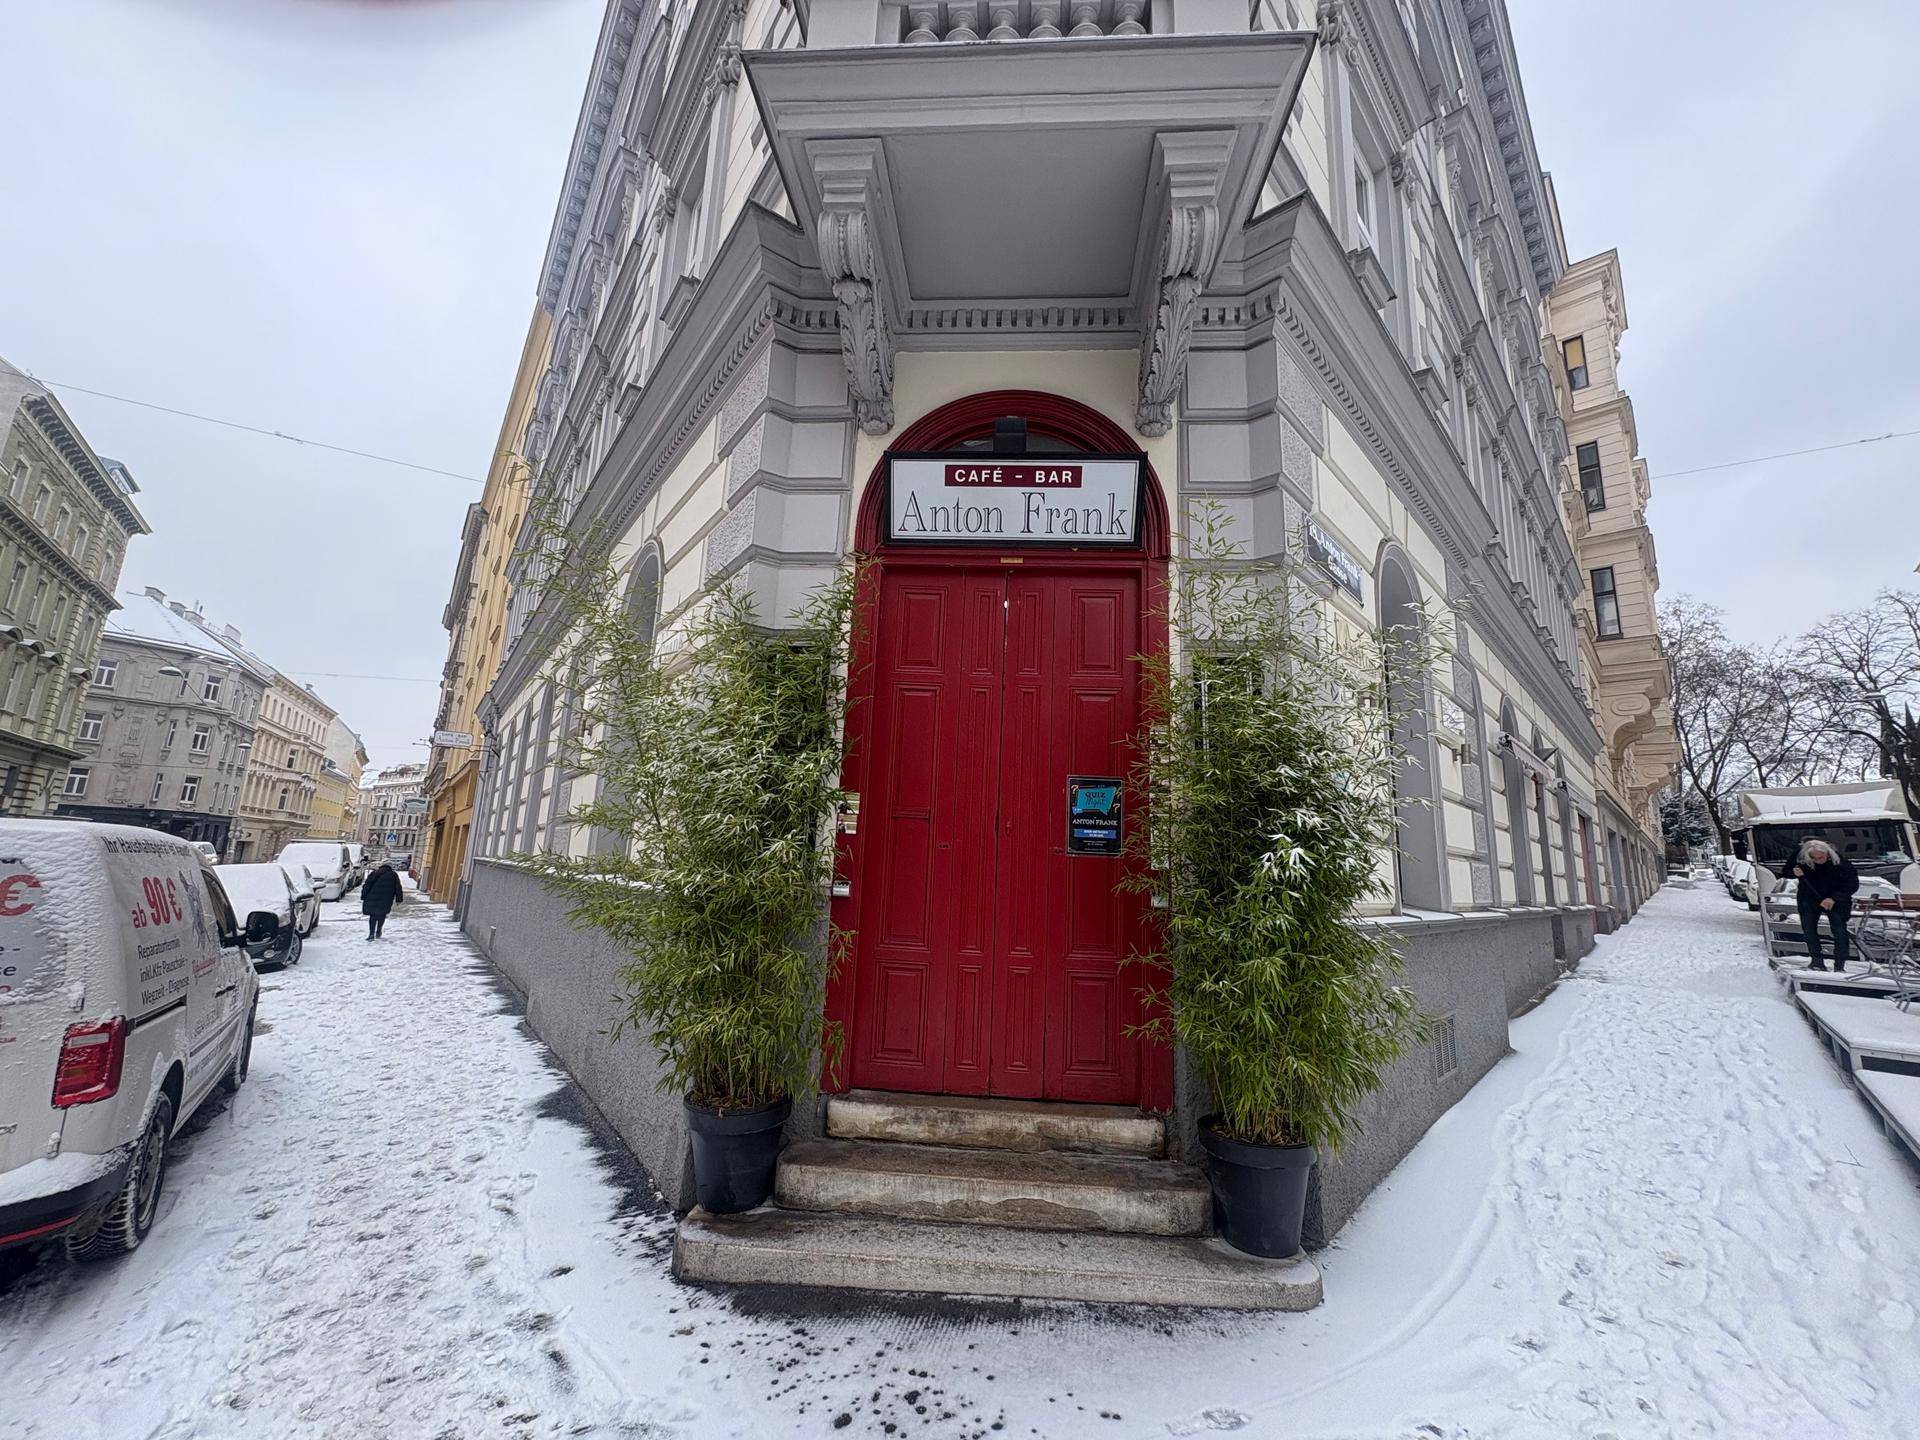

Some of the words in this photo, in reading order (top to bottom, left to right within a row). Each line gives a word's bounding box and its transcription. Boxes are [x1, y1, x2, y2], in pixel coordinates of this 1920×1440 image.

[955, 467, 1003, 483] CAFÉ
[1035, 471, 1073, 483] BAR
[898, 490, 1004, 534] Anton
[1020, 491, 1128, 535] Frank
[1328, 554, 1348, 584] Gasse
[101, 836, 119, 854] Ihr
[131, 902, 147, 928] ab
